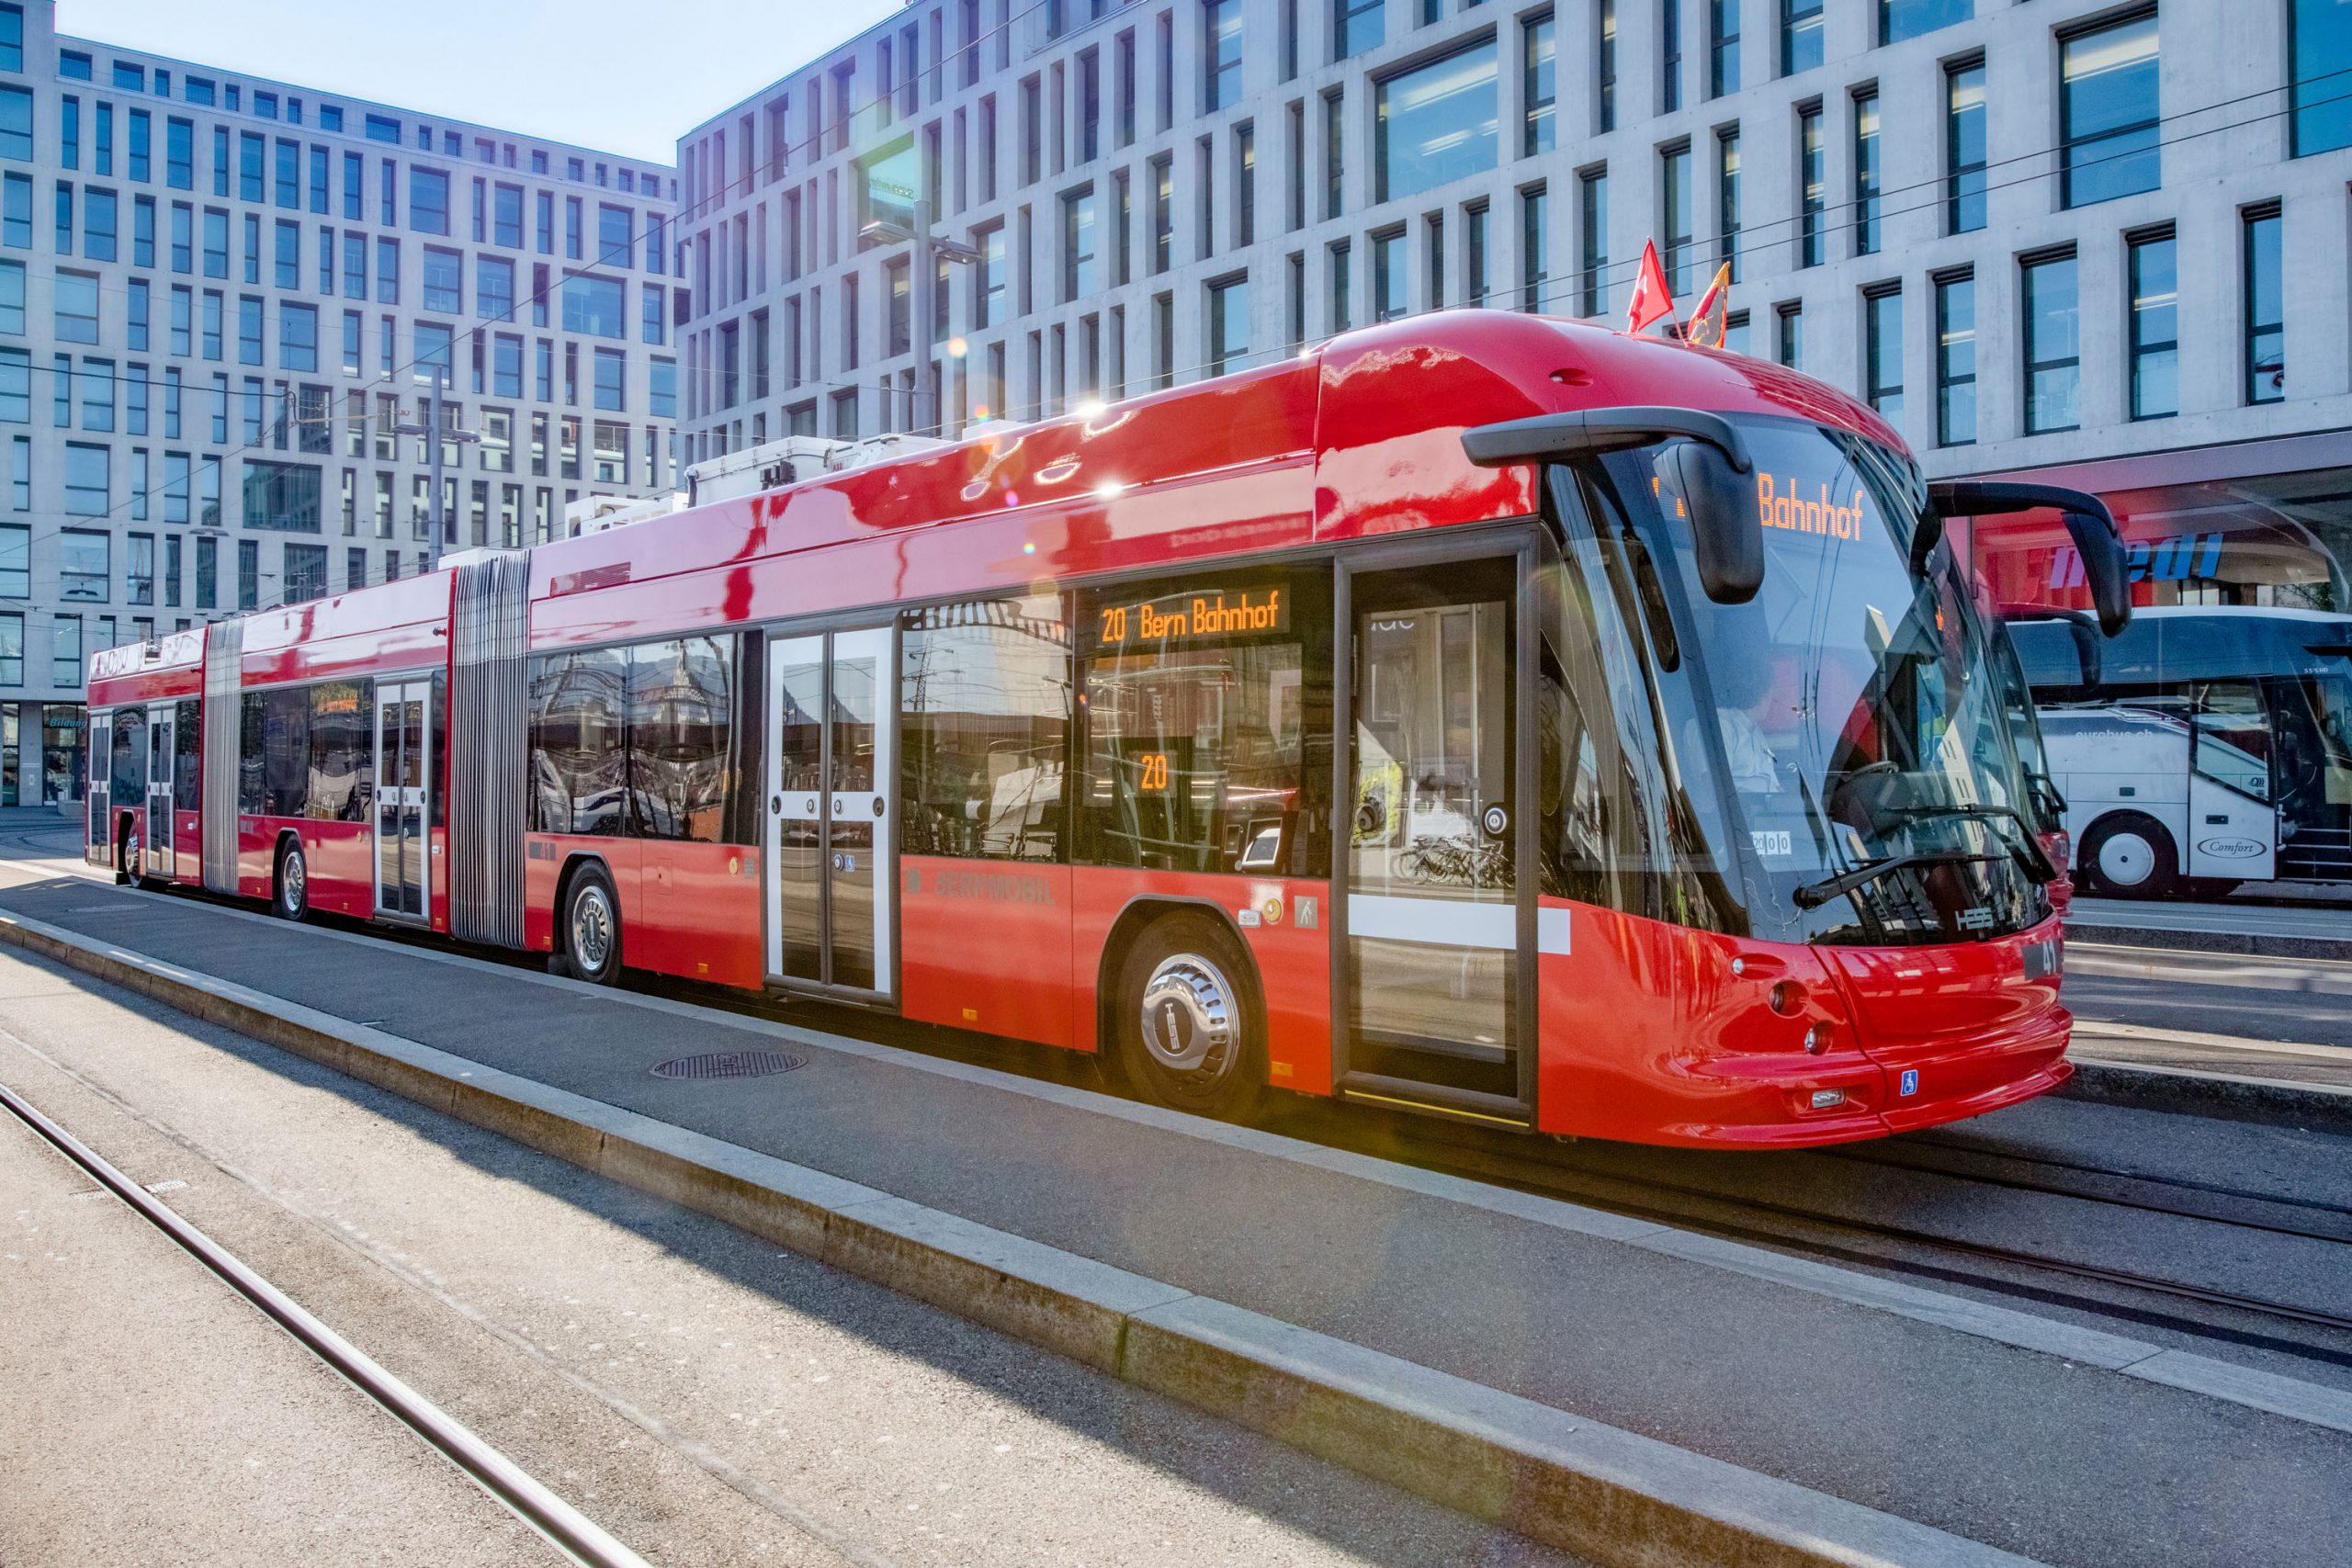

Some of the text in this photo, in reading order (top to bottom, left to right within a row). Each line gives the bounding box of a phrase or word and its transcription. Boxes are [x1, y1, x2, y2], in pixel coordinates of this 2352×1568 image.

[1758, 473, 1863, 542] Bahnhof
[1102, 591, 1279, 642] 20 Bern Bahnhof
[50, 718, 87, 728] Bildung
[1141, 755, 1167, 789] 20
[2210, 840, 2254, 855] Comfort
[1955, 907, 1995, 931] HESS
[2042, 939, 2057, 976] 41
